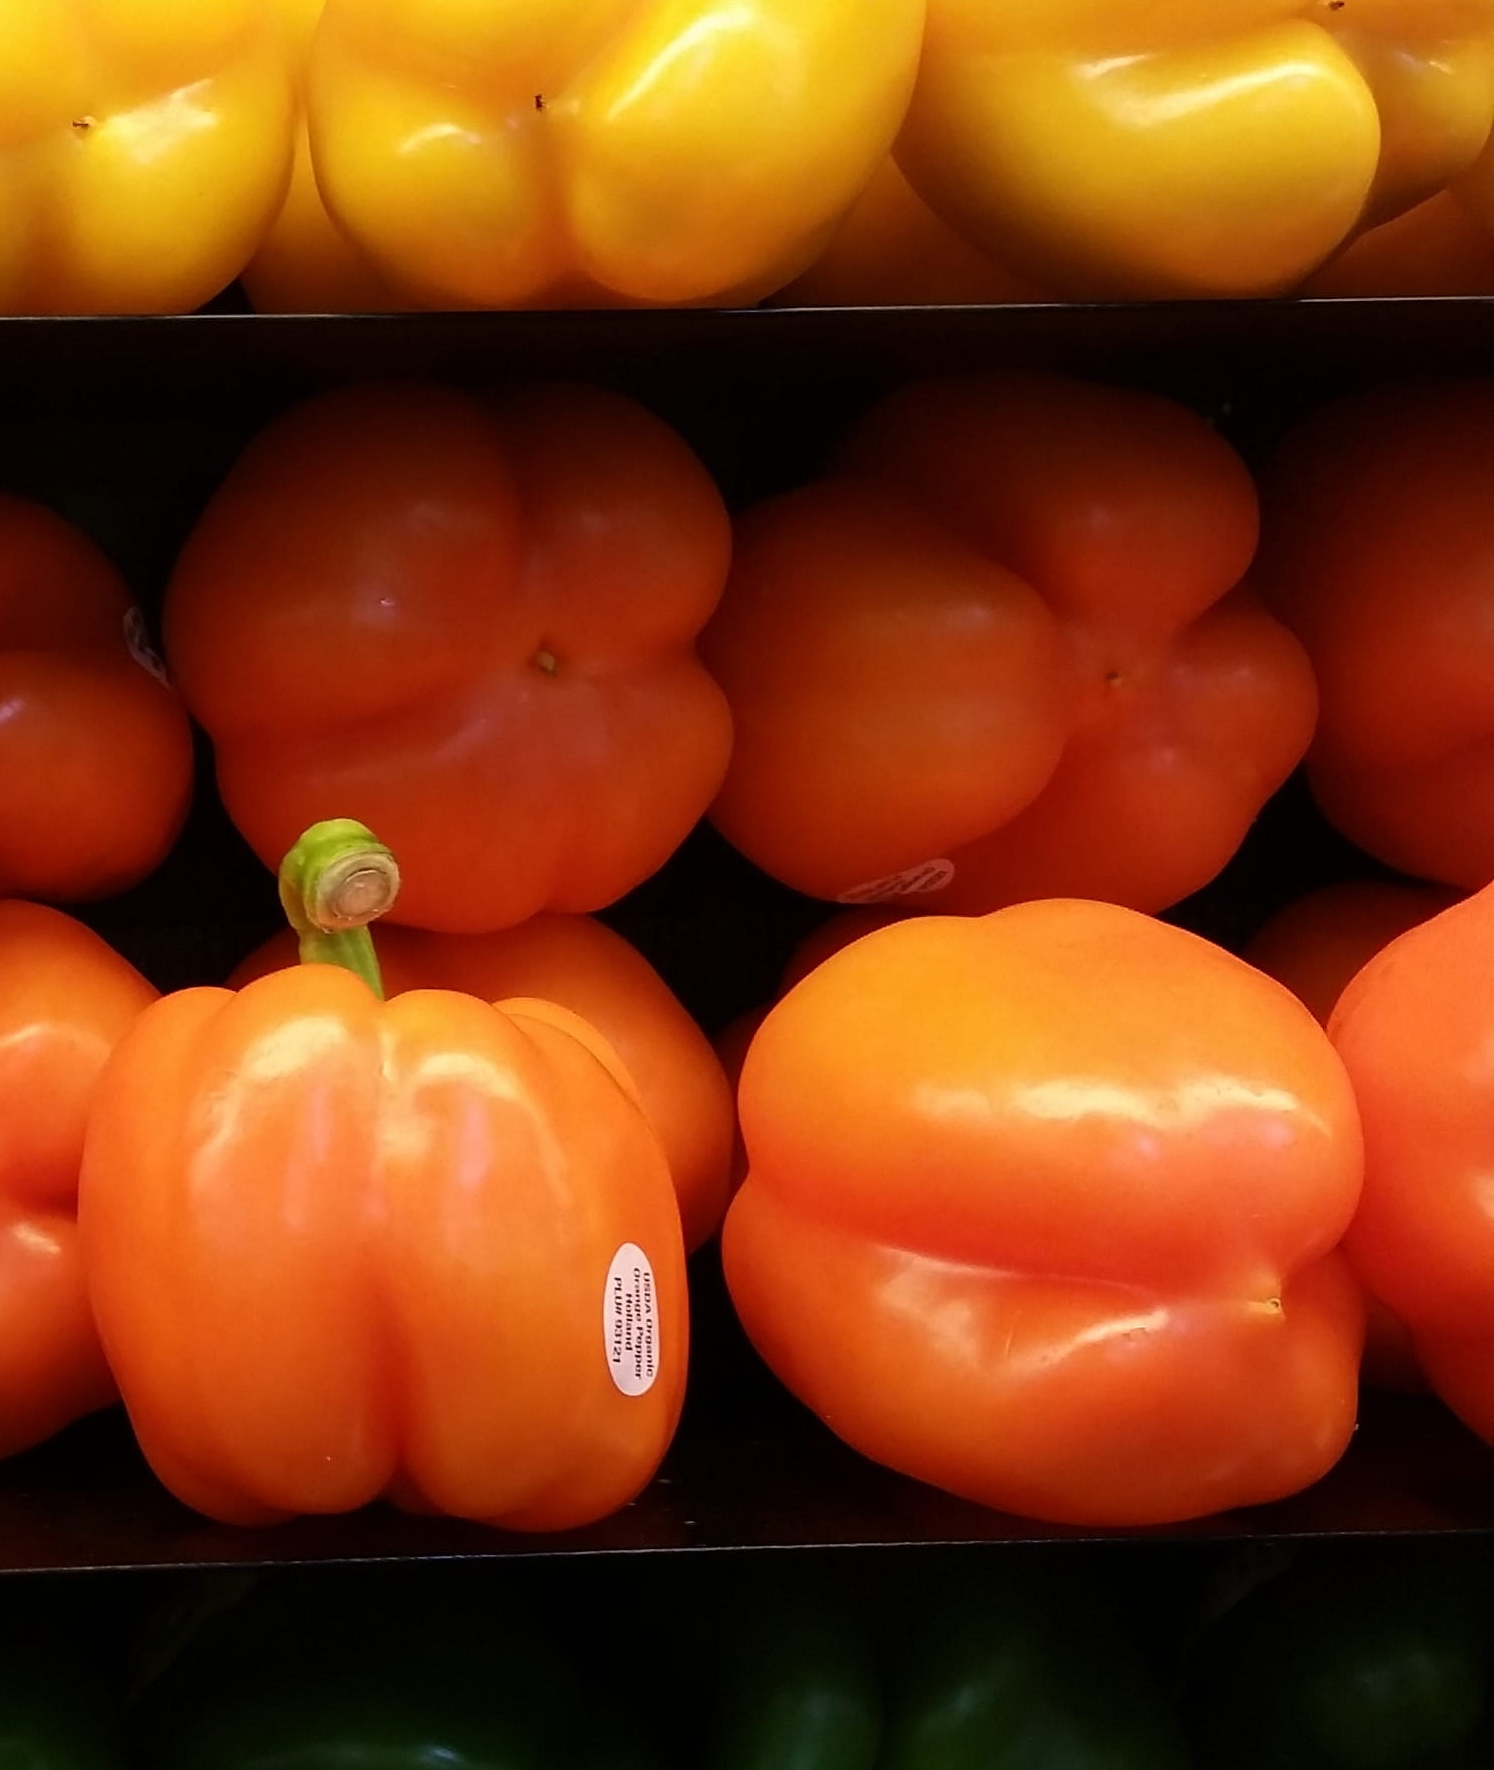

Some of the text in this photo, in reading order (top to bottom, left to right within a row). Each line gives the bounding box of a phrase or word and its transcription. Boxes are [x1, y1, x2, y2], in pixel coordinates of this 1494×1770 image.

[612, 1276, 623, 1364] PLU# 93121
[625, 1293, 633, 1352] Holland
[632, 1267, 644, 1381] Orange Pepper
[643, 1272, 655, 1378] USDA Organic
